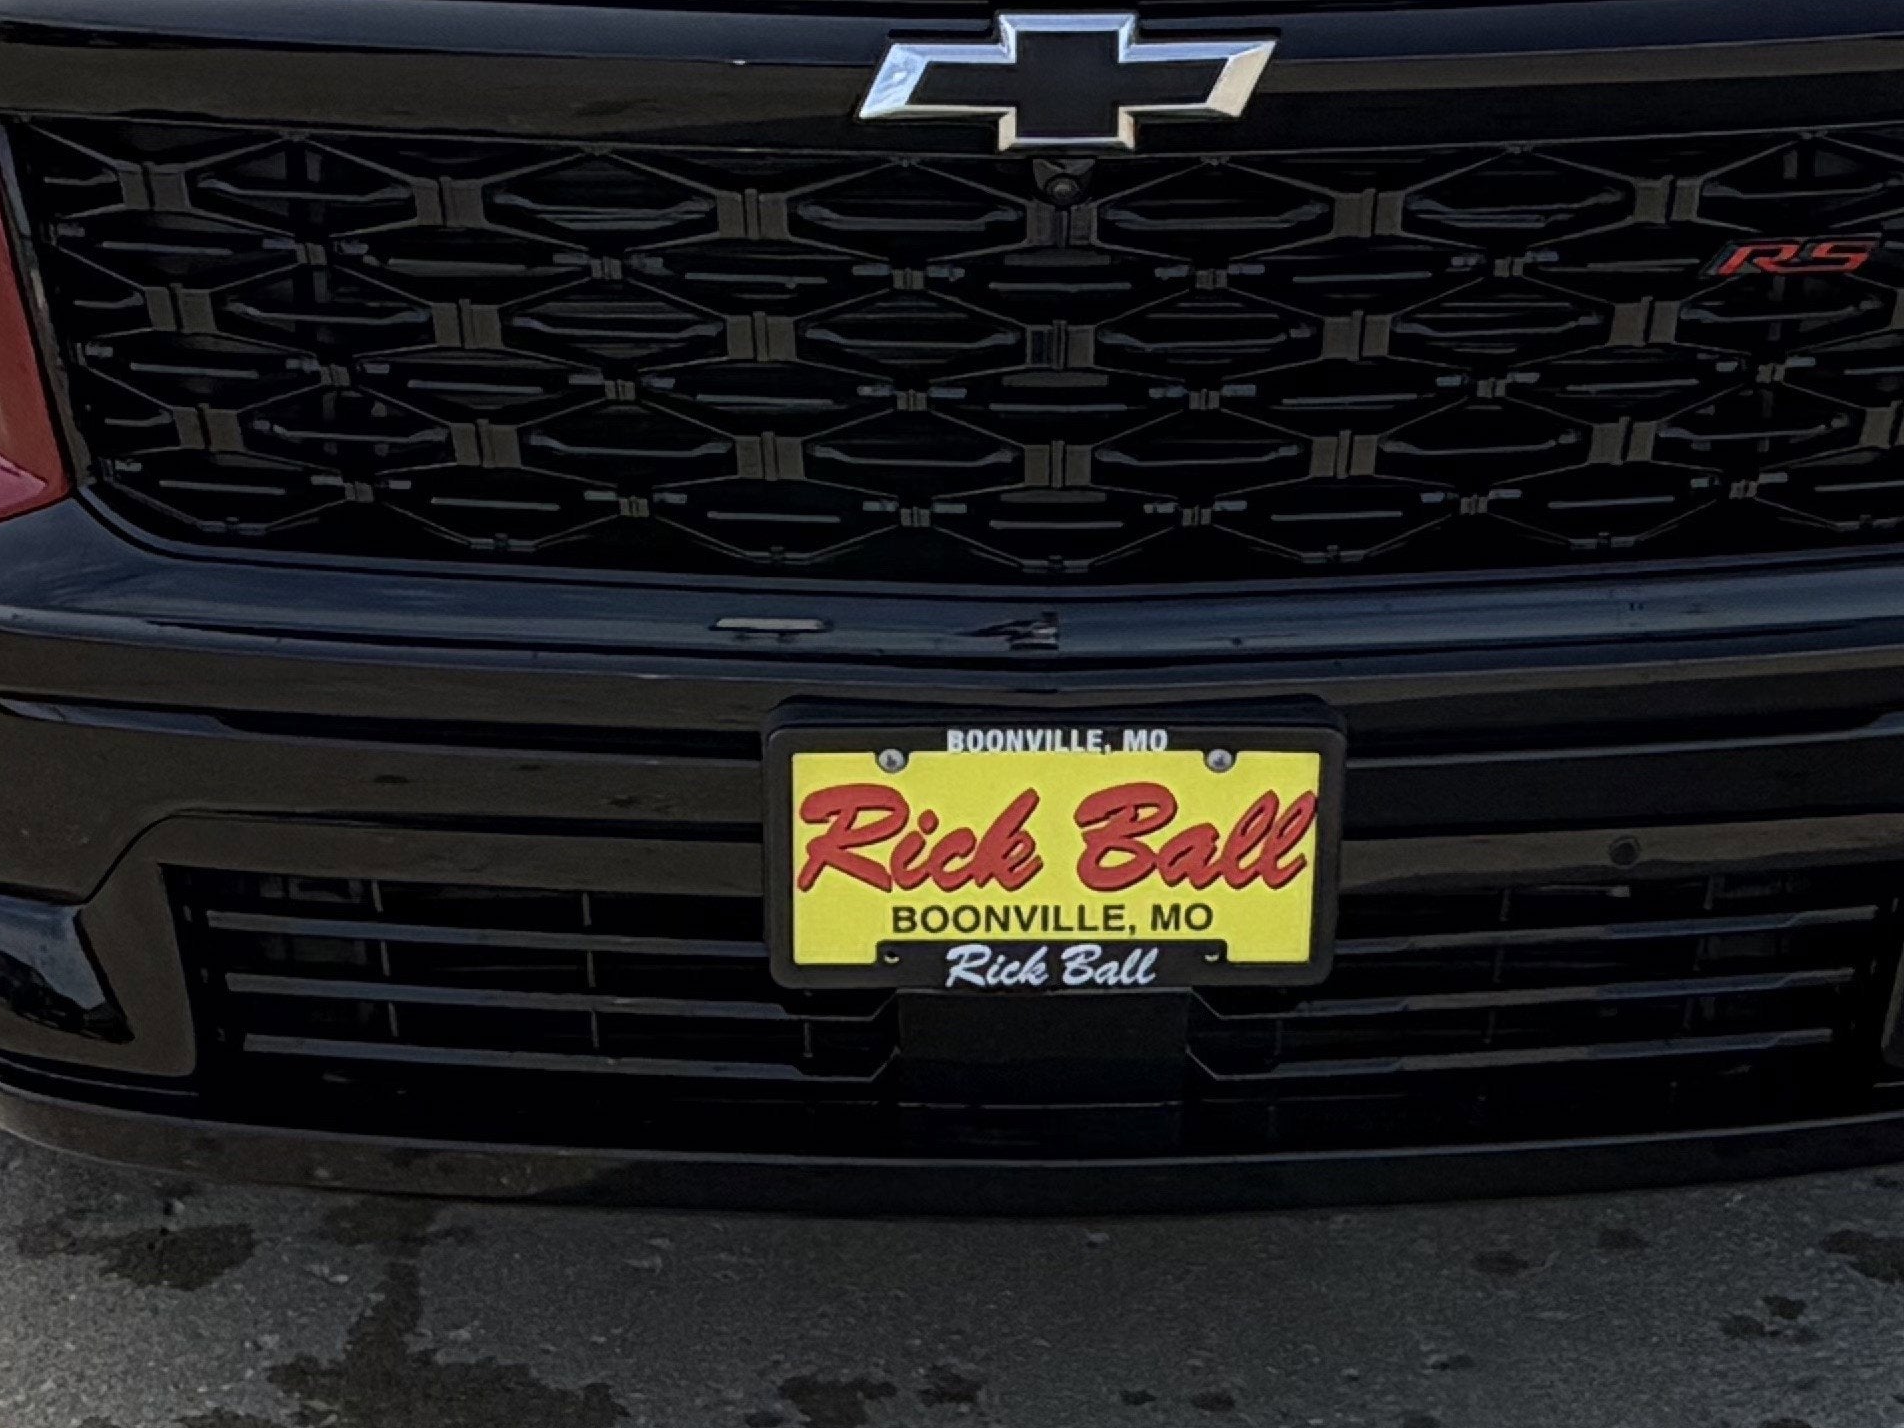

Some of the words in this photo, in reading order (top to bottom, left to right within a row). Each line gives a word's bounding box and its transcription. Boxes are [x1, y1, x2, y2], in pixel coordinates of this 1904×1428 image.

[1708, 237, 1880, 275] RS
[946, 729, 1112, 754] BOONVILLE,
[1122, 729, 1168, 752] MO
[797, 782, 1044, 893] Rick
[1073, 782, 1318, 892] Ball
[892, 903, 1137, 936] BOONVILLE,
[1150, 903, 1214, 932] MO
[945, 943, 1050, 988] Rick
[1060, 943, 1160, 986] Ball
